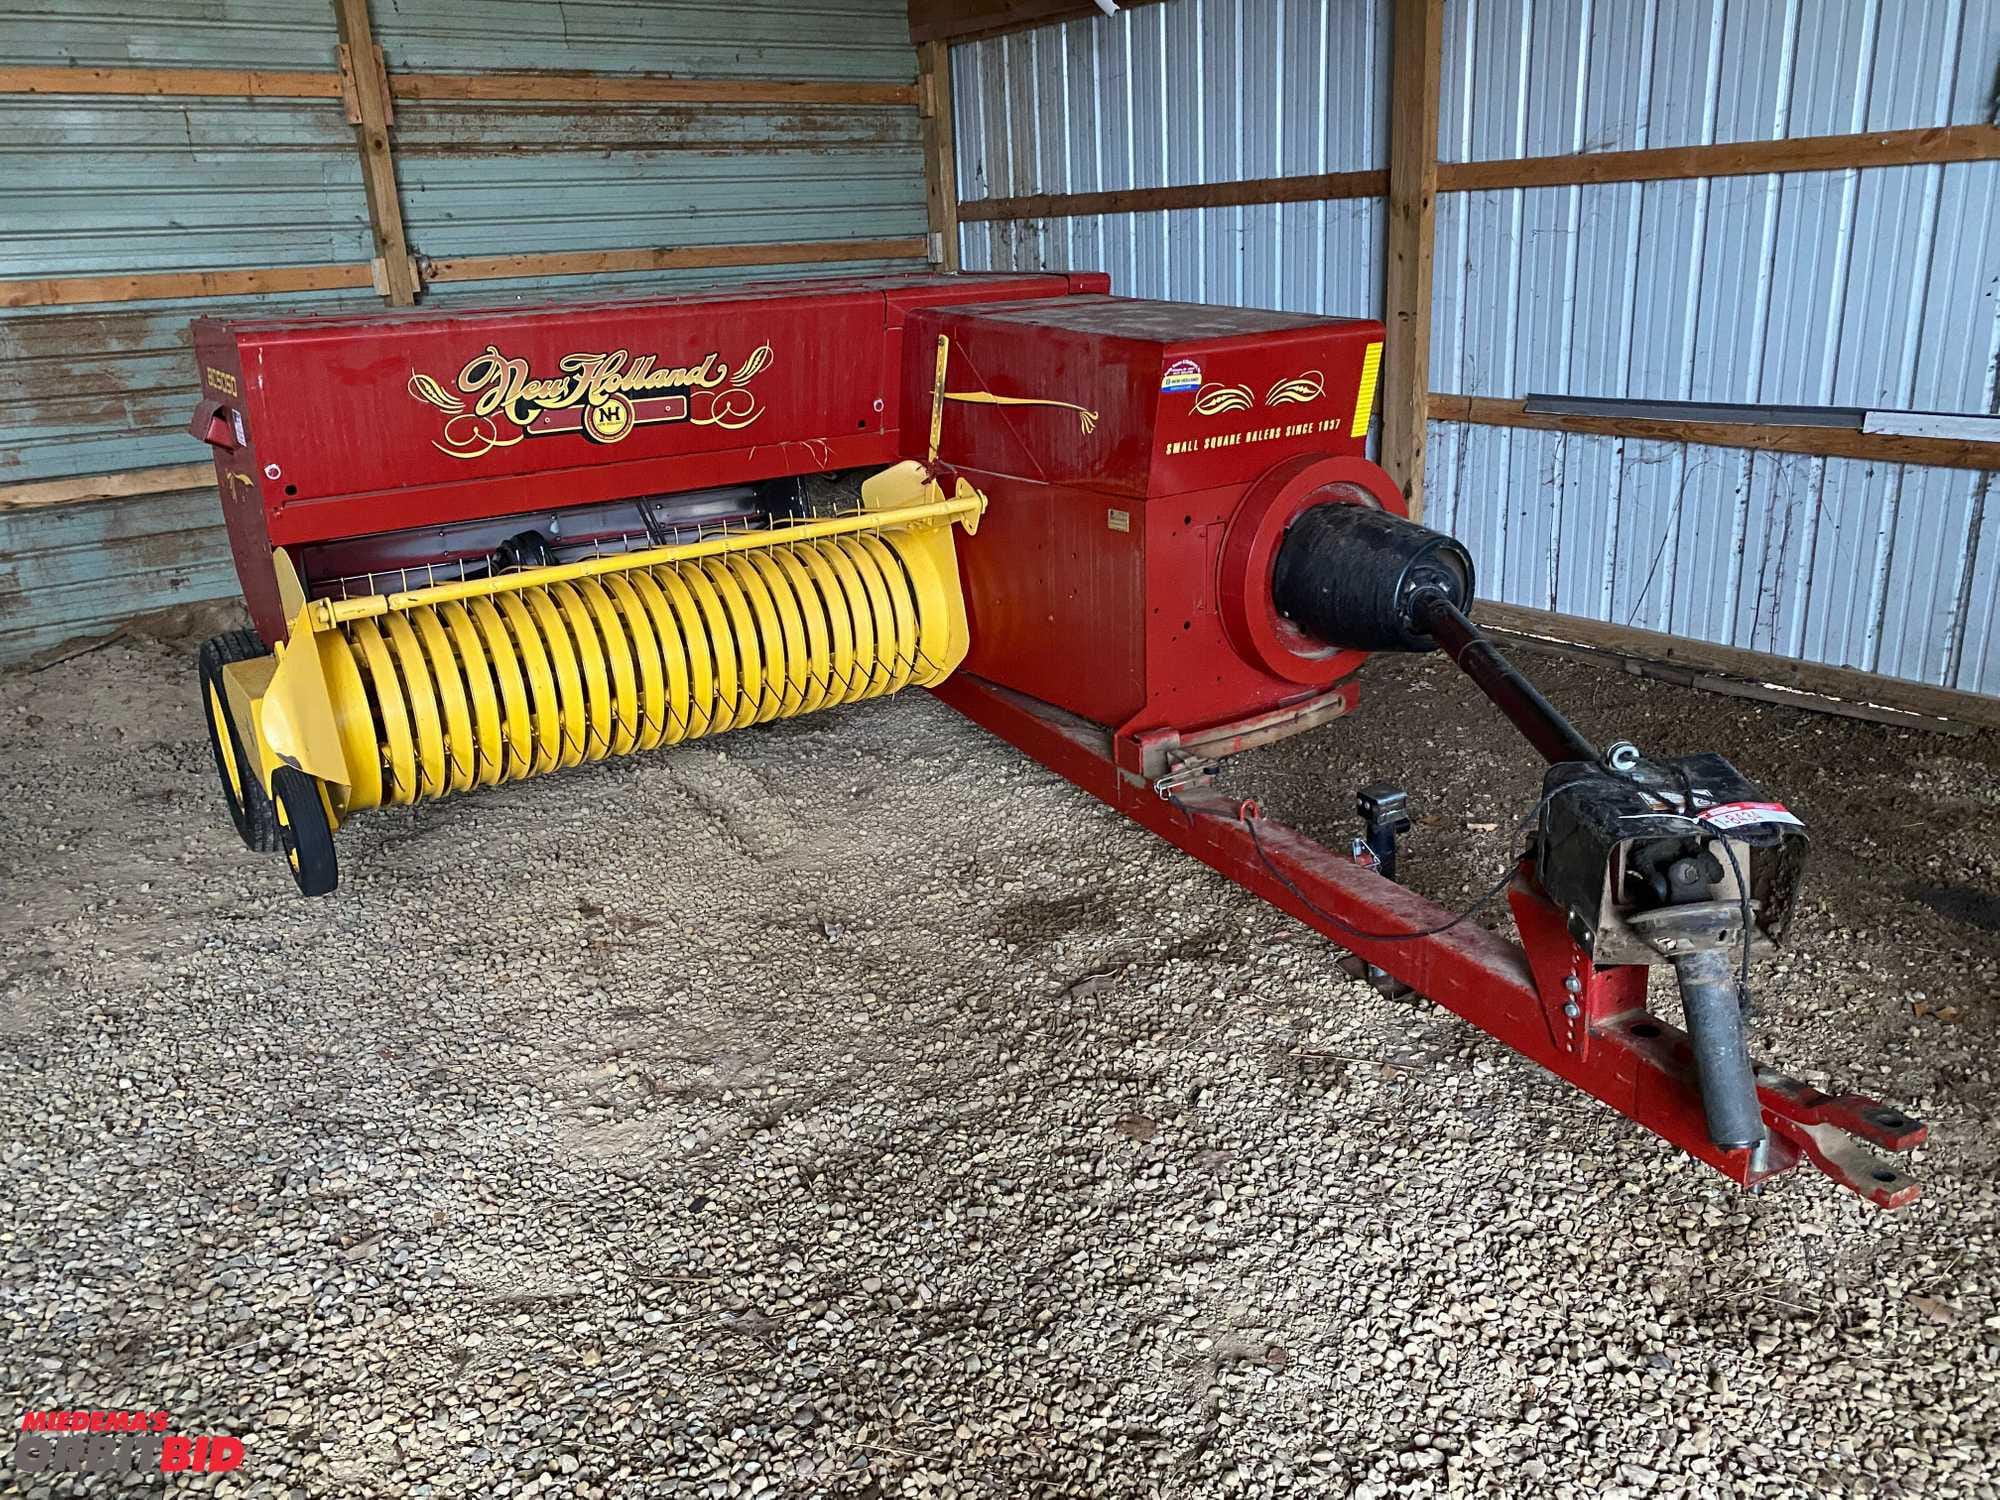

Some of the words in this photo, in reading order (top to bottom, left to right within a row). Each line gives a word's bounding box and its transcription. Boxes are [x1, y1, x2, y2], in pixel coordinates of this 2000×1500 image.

[458, 346, 569, 425] New
[560, 349, 727, 406] Holland
[599, 406, 620, 422] NH
[1165, 440, 1199, 455] SMALL
[1203, 433, 1241, 449] SQUARE
[1245, 427, 1281, 443] BALERS
[1285, 423, 1313, 437] SINCE
